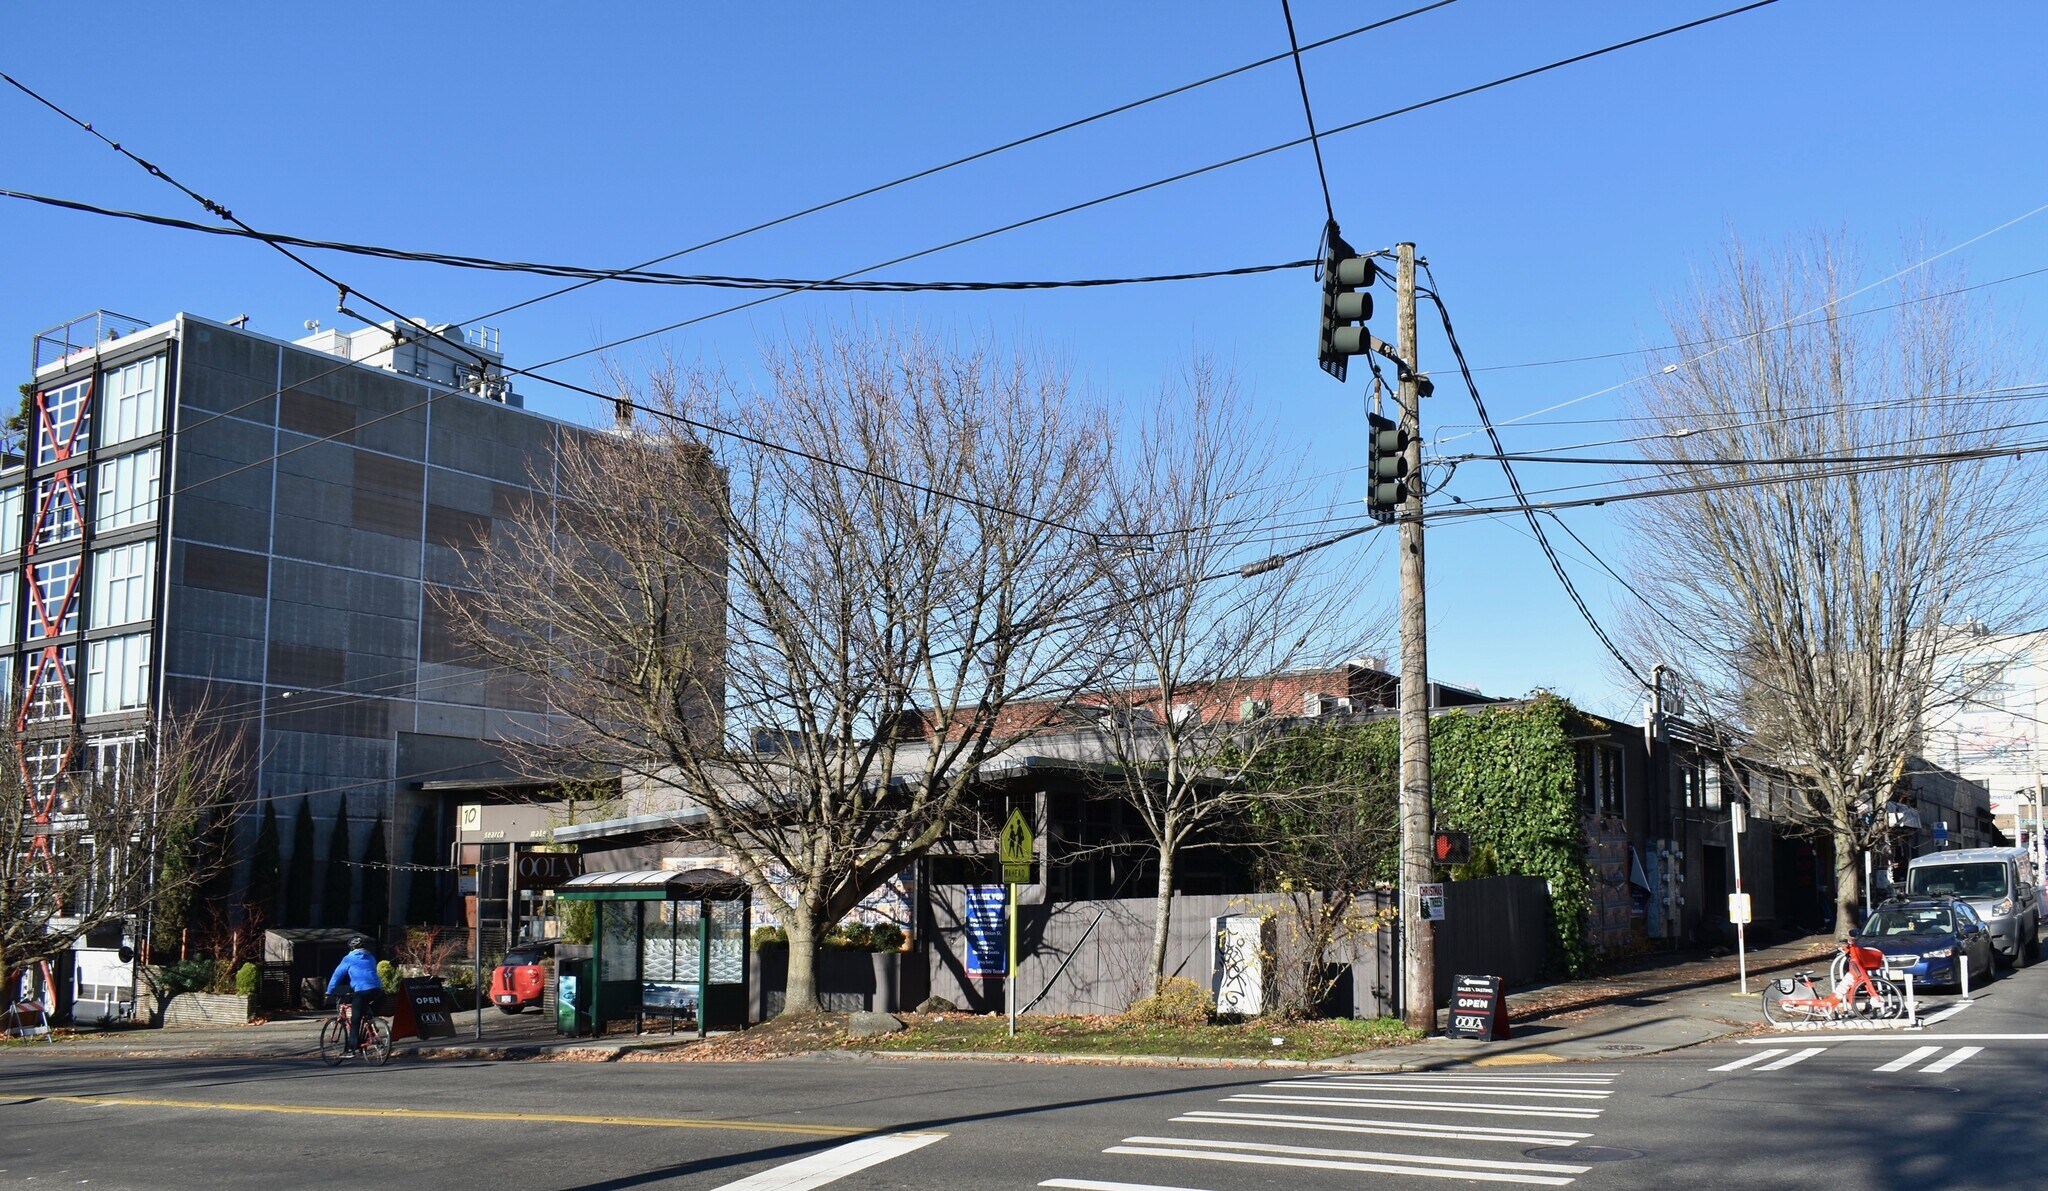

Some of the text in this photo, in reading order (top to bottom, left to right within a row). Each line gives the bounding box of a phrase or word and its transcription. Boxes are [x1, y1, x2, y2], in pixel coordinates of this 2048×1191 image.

[484, 830, 505, 838] search
[519, 856, 577, 878] OOLA
[1008, 868, 1026, 878] AHEAD
[991, 893, 1006, 901] YOU
[1458, 998, 1488, 1009] OPEN
[1455, 1016, 1484, 1030] OOLA
